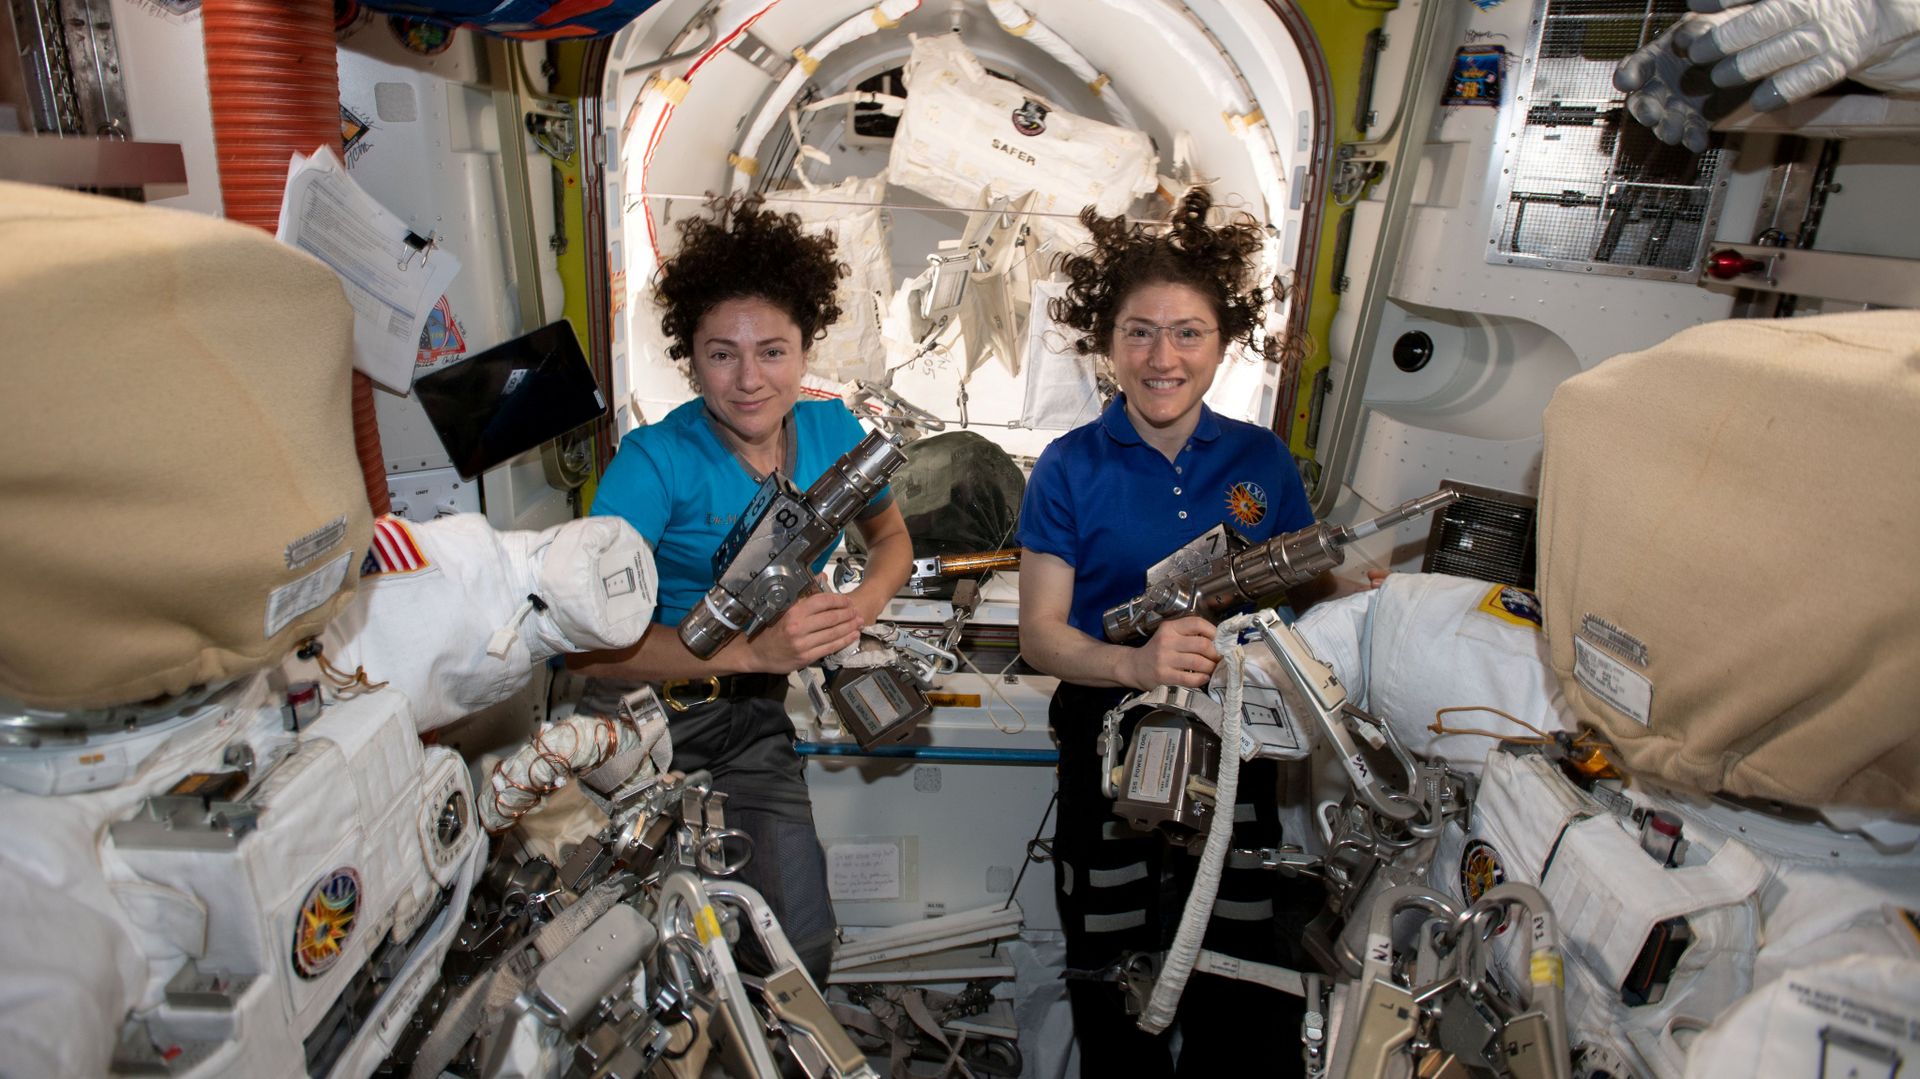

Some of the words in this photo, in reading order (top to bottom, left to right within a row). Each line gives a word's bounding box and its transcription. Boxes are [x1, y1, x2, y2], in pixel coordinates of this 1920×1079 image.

[991, 138, 1036, 166] SAFER
[776, 508, 798, 529] 8
[1206, 533, 1220, 555] 7
[1134, 753, 1143, 778] POWER
